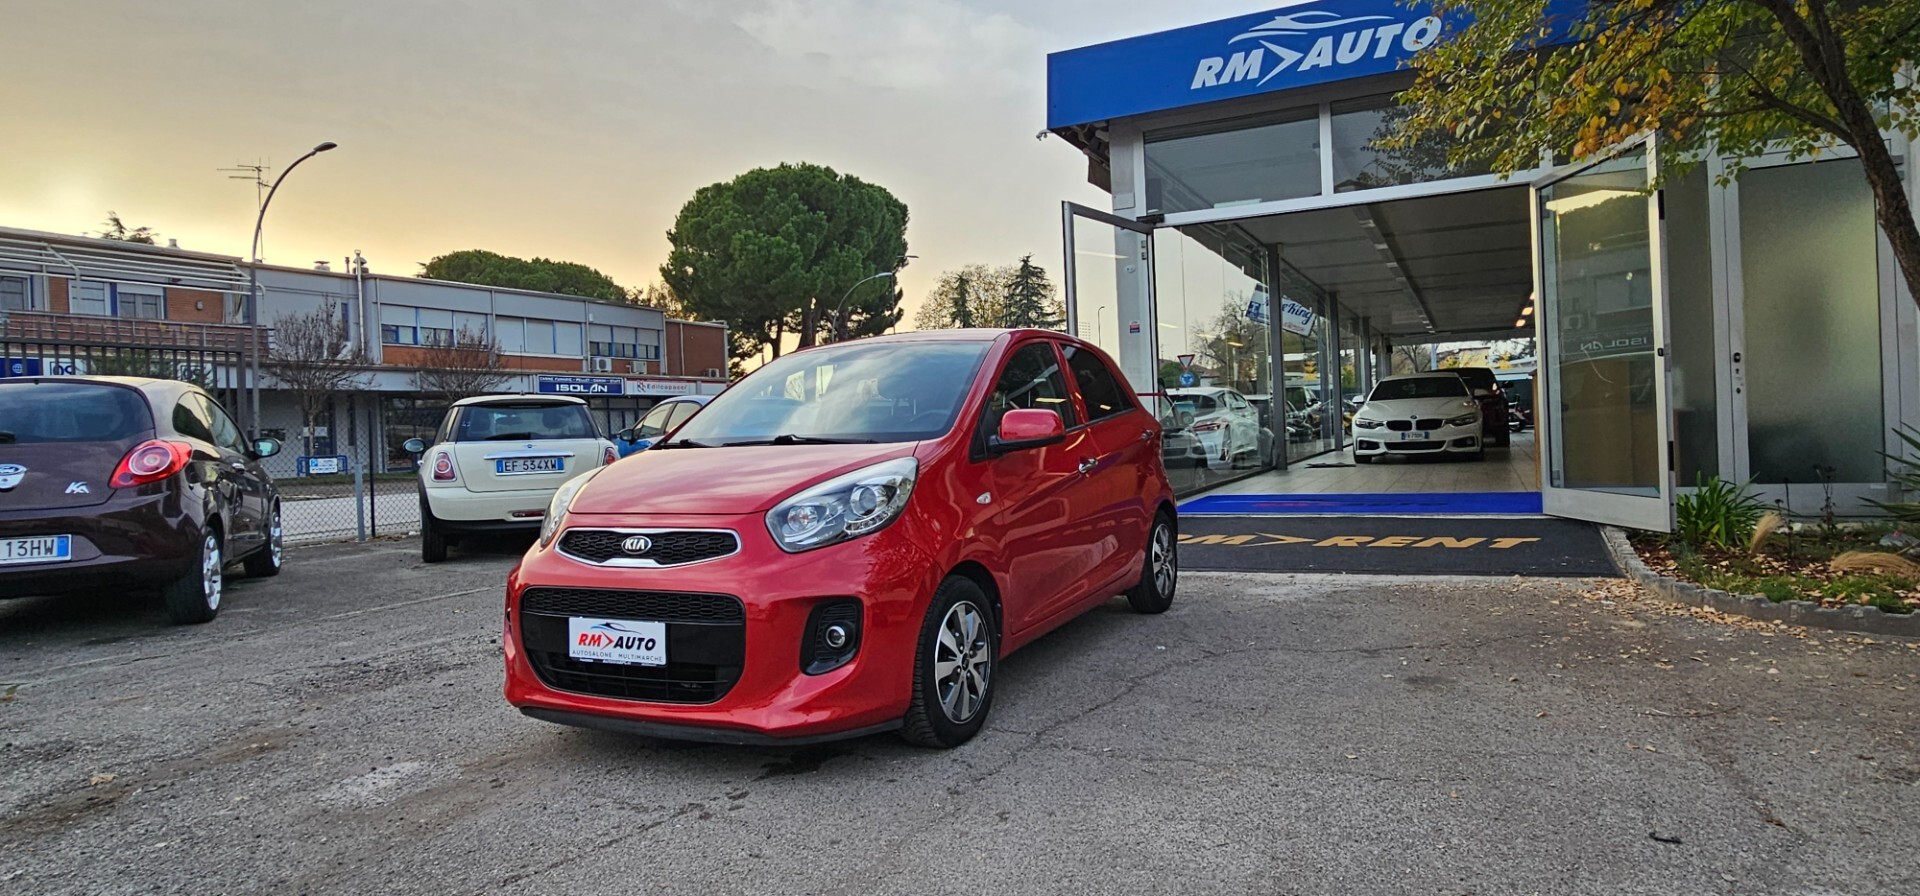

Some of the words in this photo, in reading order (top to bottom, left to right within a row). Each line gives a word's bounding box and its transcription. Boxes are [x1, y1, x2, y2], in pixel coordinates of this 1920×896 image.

[1190, 48, 1265, 90] RM
[1297, 16, 1442, 72] AUTO
[556, 383, 607, 394] ISOLAN
[505, 460, 519, 472] EF
[6, 539, 55, 558] 13HW
[625, 538, 645, 550] KIA
[1312, 535, 1541, 549] RENT
[578, 633, 602, 647] RM
[613, 635, 656, 652] AUTO
[572, 649, 612, 658] AUTOSALONE
[618, 653, 663, 663] MULTIMARCHE
